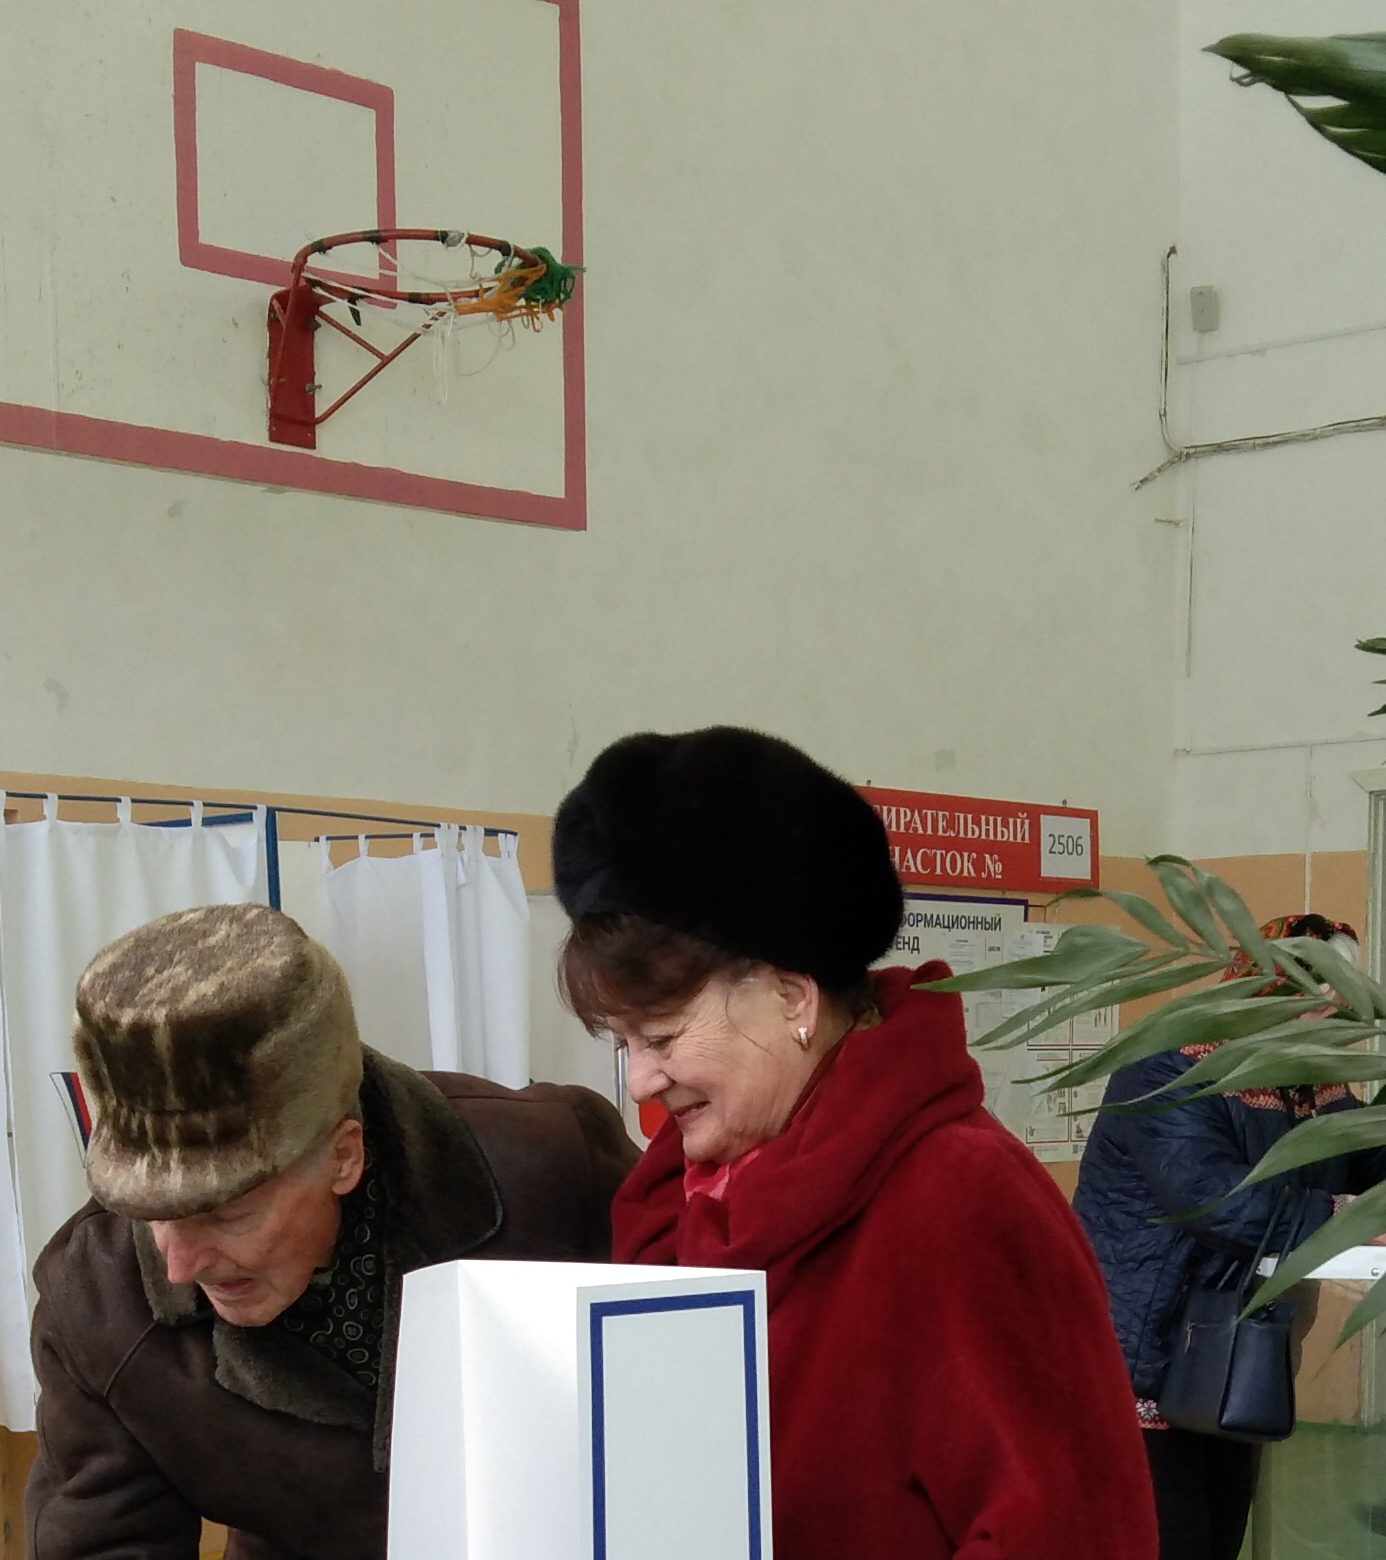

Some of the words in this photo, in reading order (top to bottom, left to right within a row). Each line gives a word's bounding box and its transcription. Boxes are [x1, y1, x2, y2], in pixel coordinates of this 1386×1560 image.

[874, 804, 1031, 844] ИРАТЕЛЬНЫЙ
[1047, 833, 1085, 857] 2506
[889, 845, 977, 878] ЧАСТОК
[981, 853, 1003, 879] №
[901, 911, 1002, 933] ОРМАЦИОННЫЙ
[894, 935, 921, 955] ЕНД
